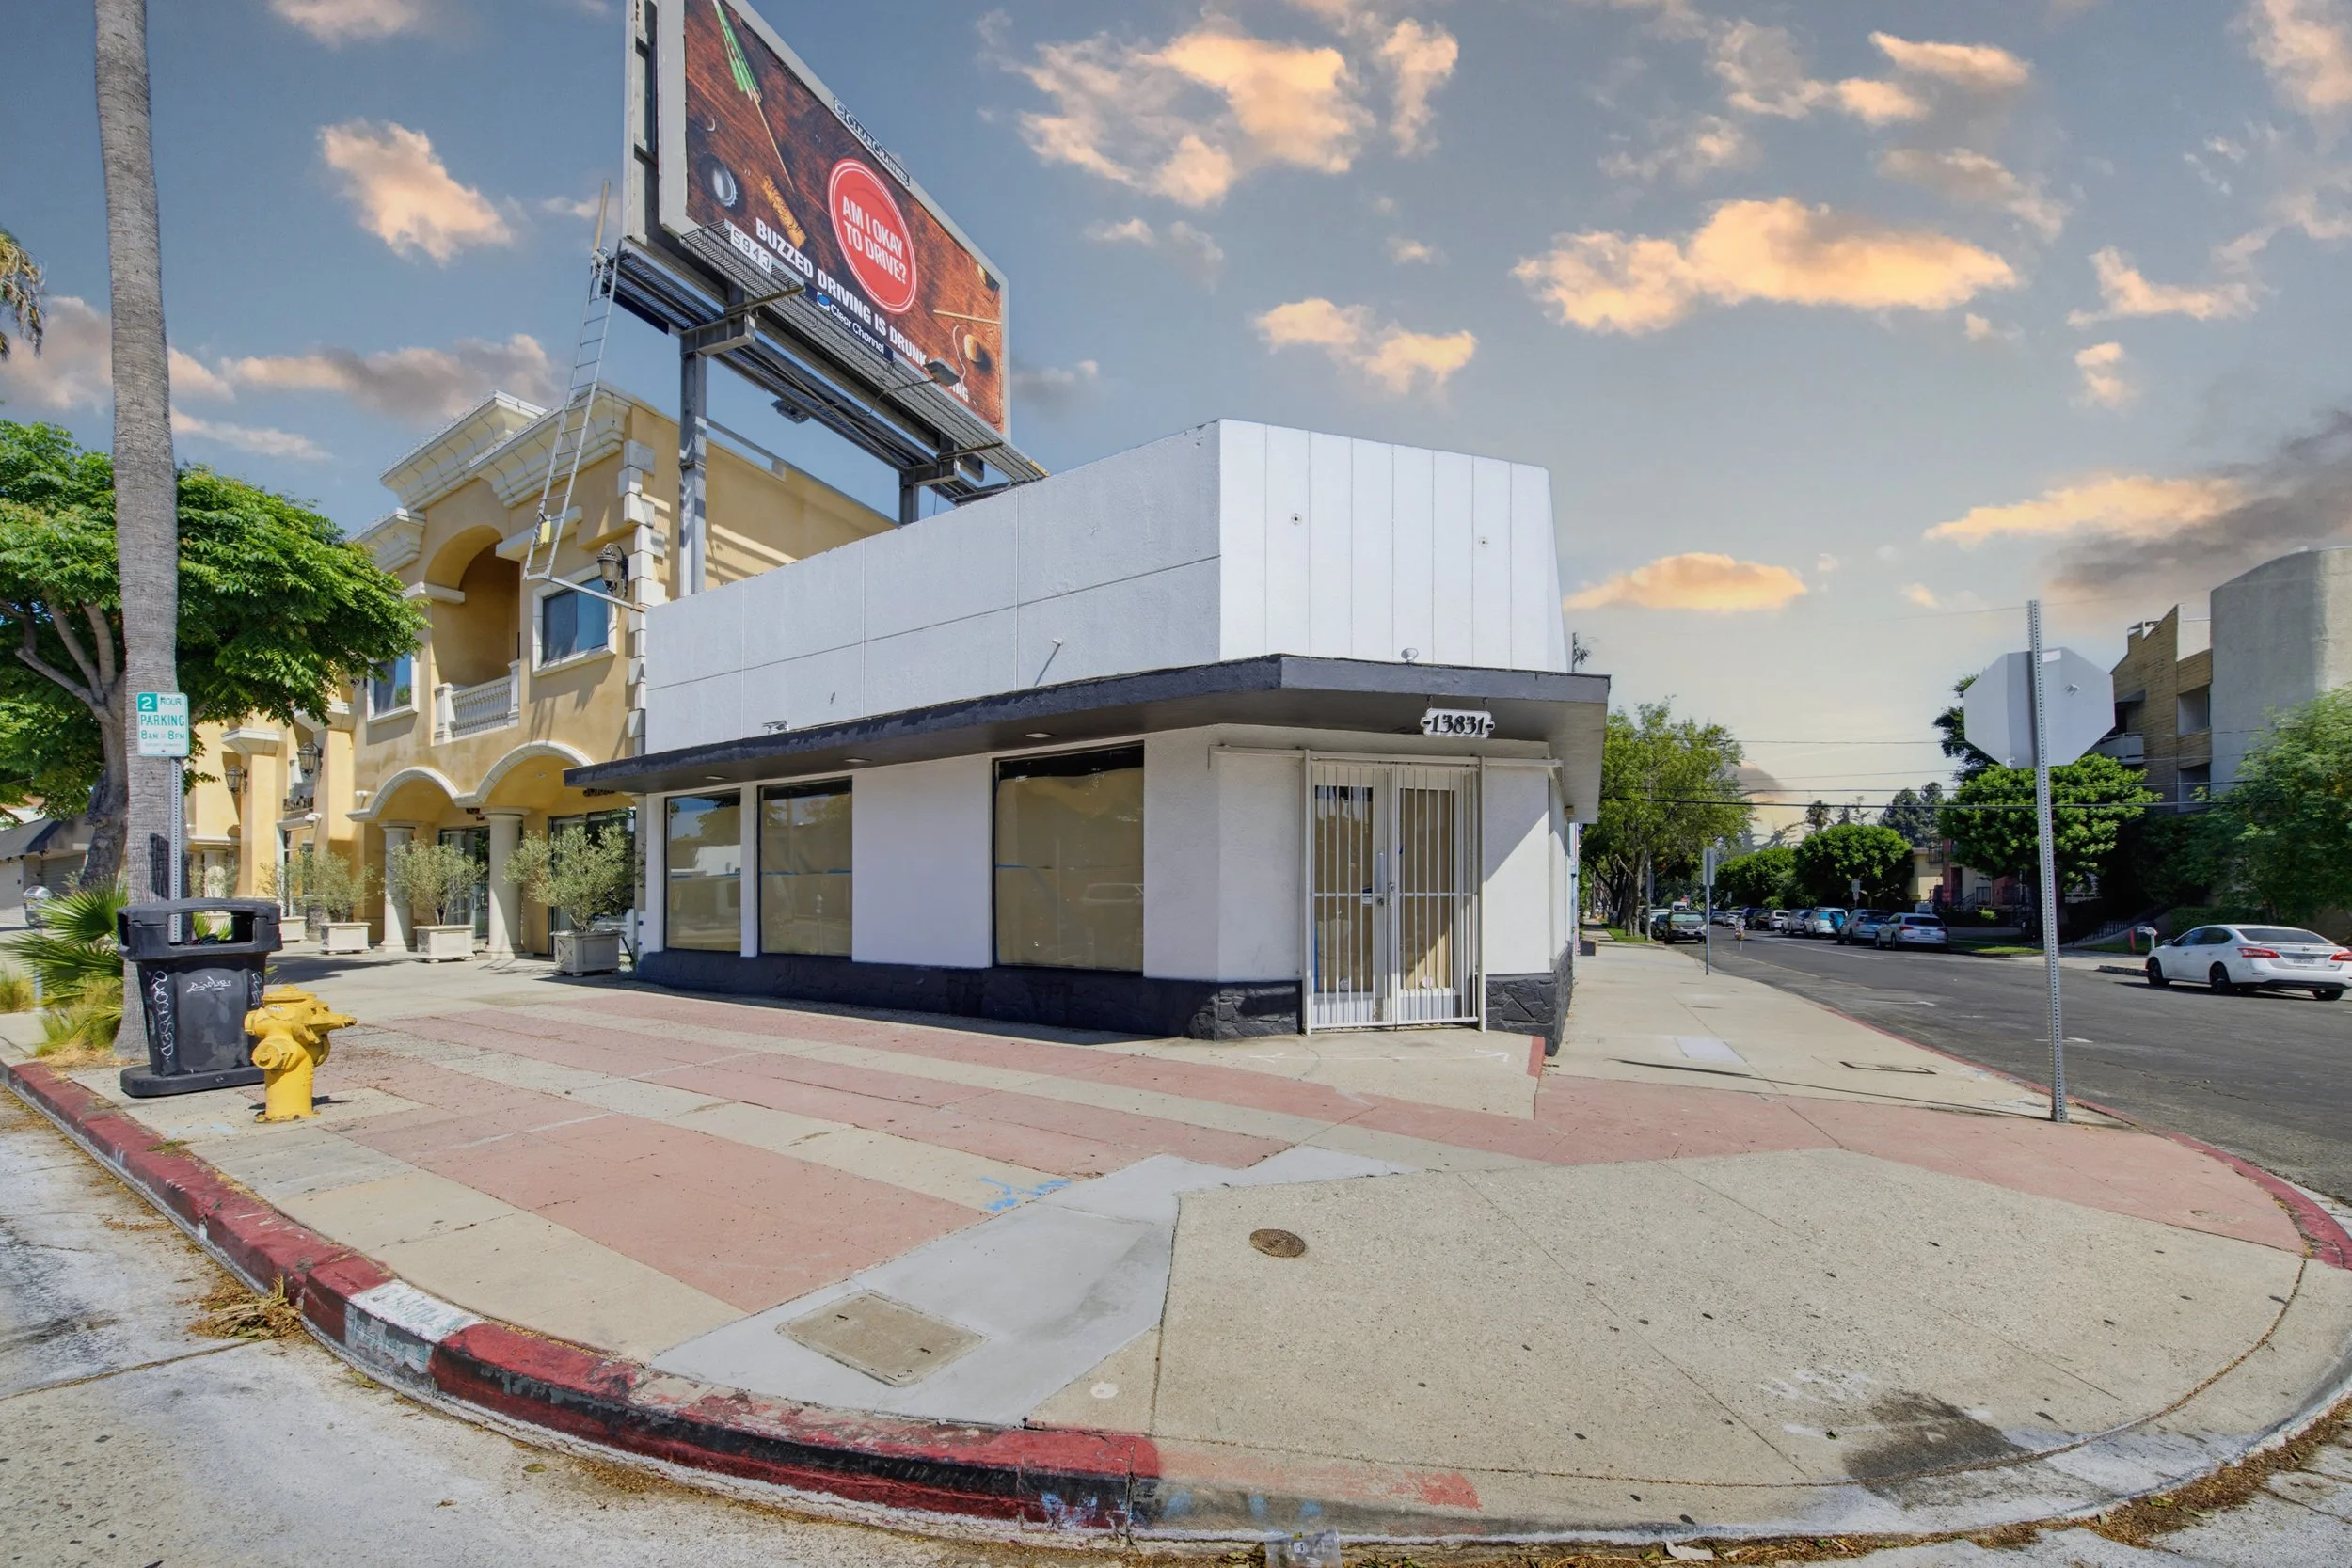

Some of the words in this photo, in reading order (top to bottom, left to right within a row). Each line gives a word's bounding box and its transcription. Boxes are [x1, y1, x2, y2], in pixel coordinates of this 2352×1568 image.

[733, 230, 771, 270] 5943
[843, 195, 864, 230] AM
[865, 212, 871, 235] I
[872, 218, 903, 260] OKAY
[843, 219, 863, 252] TO
[864, 234, 907, 286] DRIVE?
[755, 217, 814, 279] BUZZED
[818, 268, 872, 325] DRIVING
[874, 313, 887, 336] IS
[889, 325, 928, 367] DRUNK
[830, 304, 852, 328] Clear
[852, 322, 884, 354] Channel
[141, 696, 153, 710] 2
[141, 715, 185, 726] PARKING
